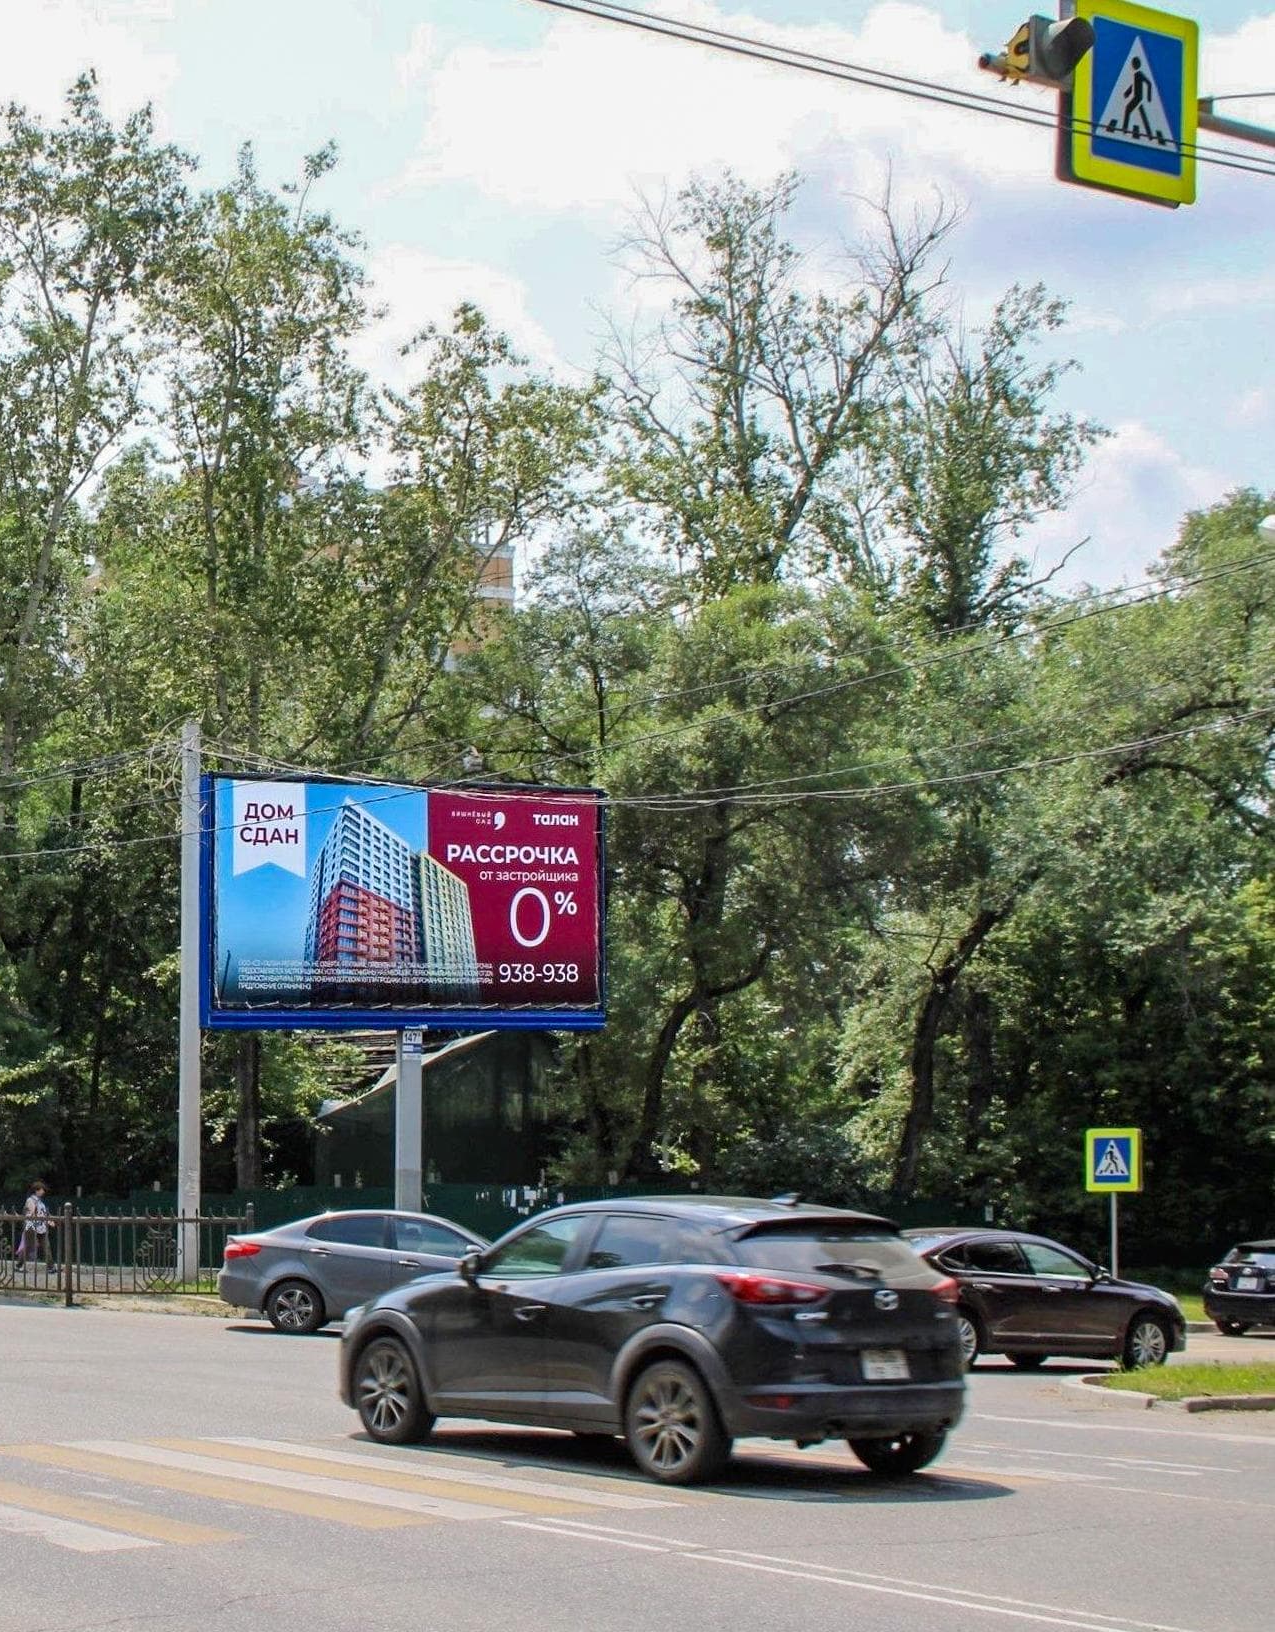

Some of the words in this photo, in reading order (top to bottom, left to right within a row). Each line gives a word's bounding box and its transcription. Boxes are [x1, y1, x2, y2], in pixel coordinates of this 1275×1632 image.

[244, 803, 293, 821] ДОМ
[532, 813, 579, 826] талан
[240, 826, 298, 846] СДАН
[446, 843, 579, 865] РАССРОЧКА
[479, 870, 493, 881] от
[496, 869, 579, 883] застройщика
[498, 963, 579, 983] 938-938
